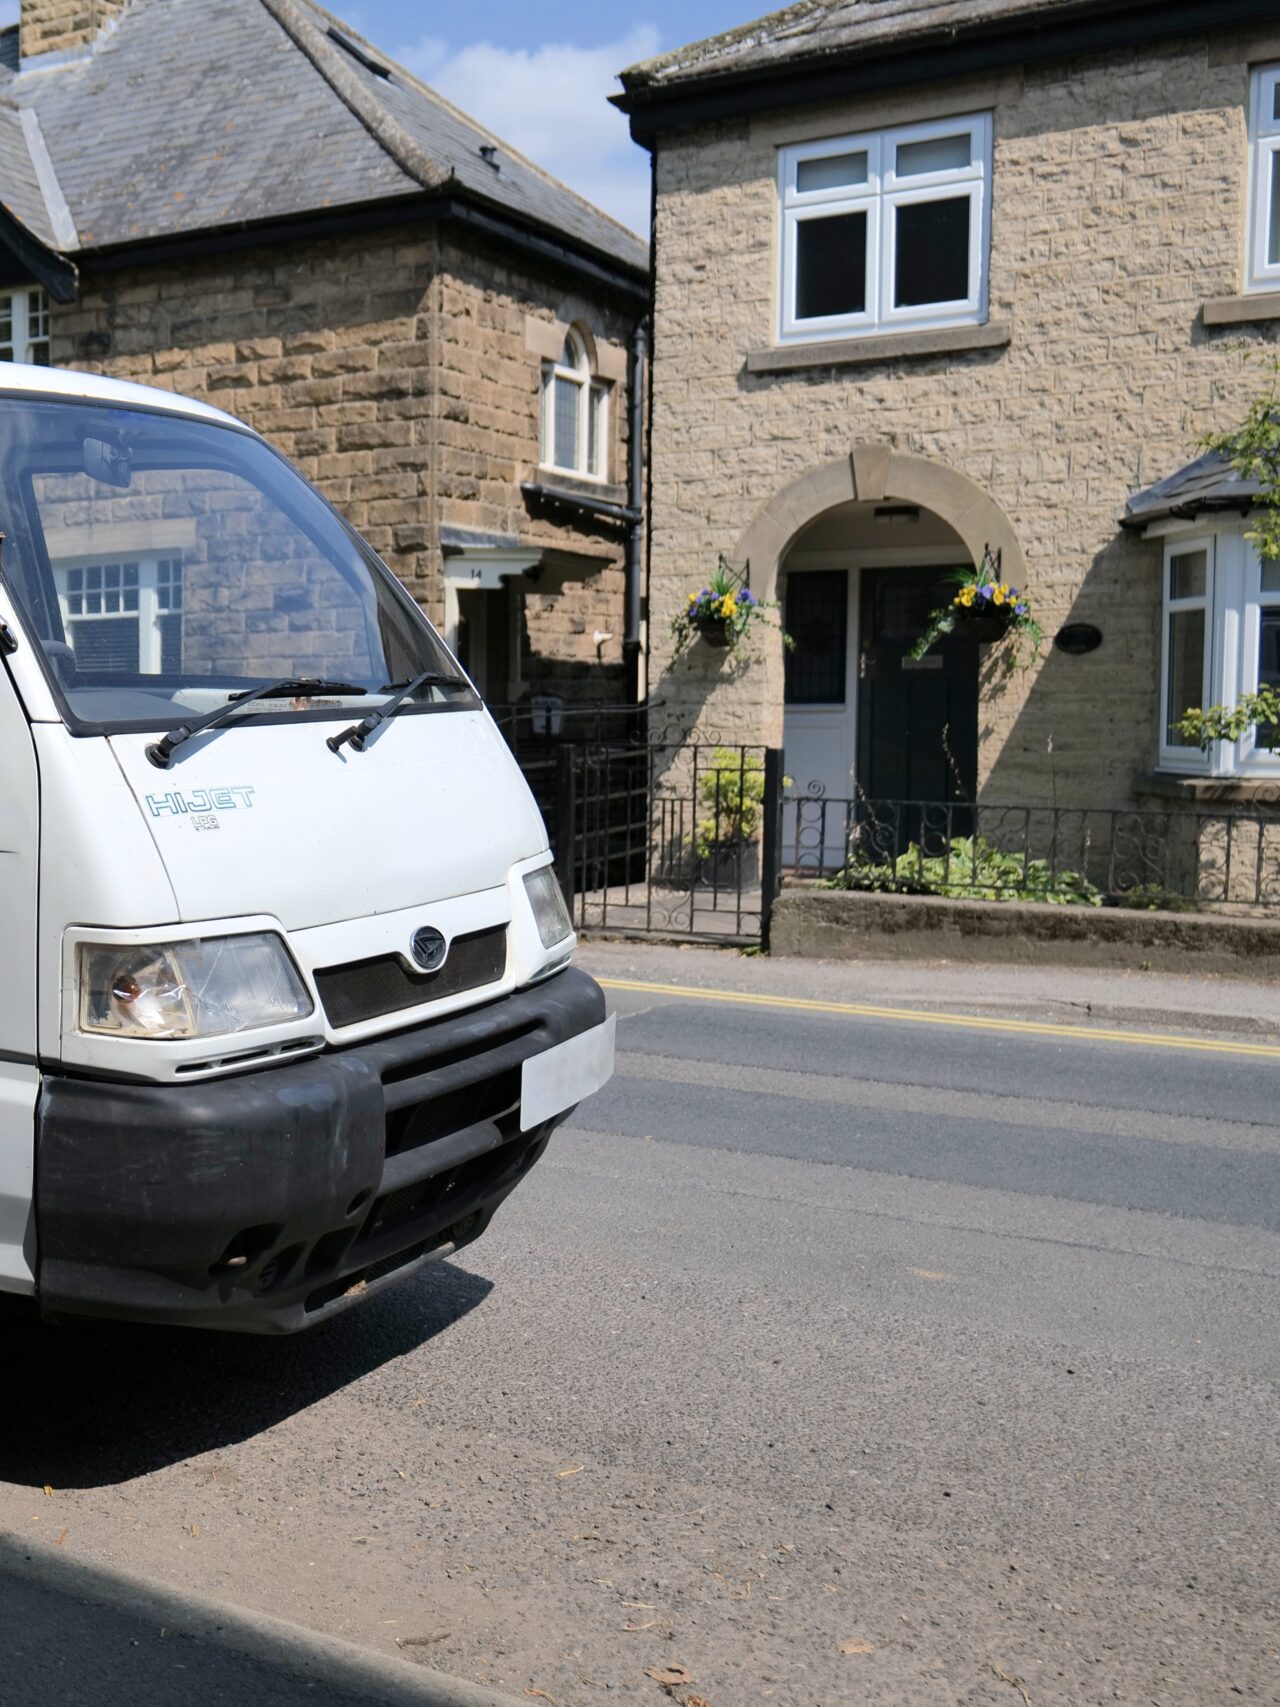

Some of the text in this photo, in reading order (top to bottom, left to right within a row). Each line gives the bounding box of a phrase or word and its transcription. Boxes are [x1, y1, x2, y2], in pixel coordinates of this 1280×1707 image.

[471, 568, 482, 580] 14
[146, 786, 254, 817] HIJET
[191, 815, 218, 828] LPG
